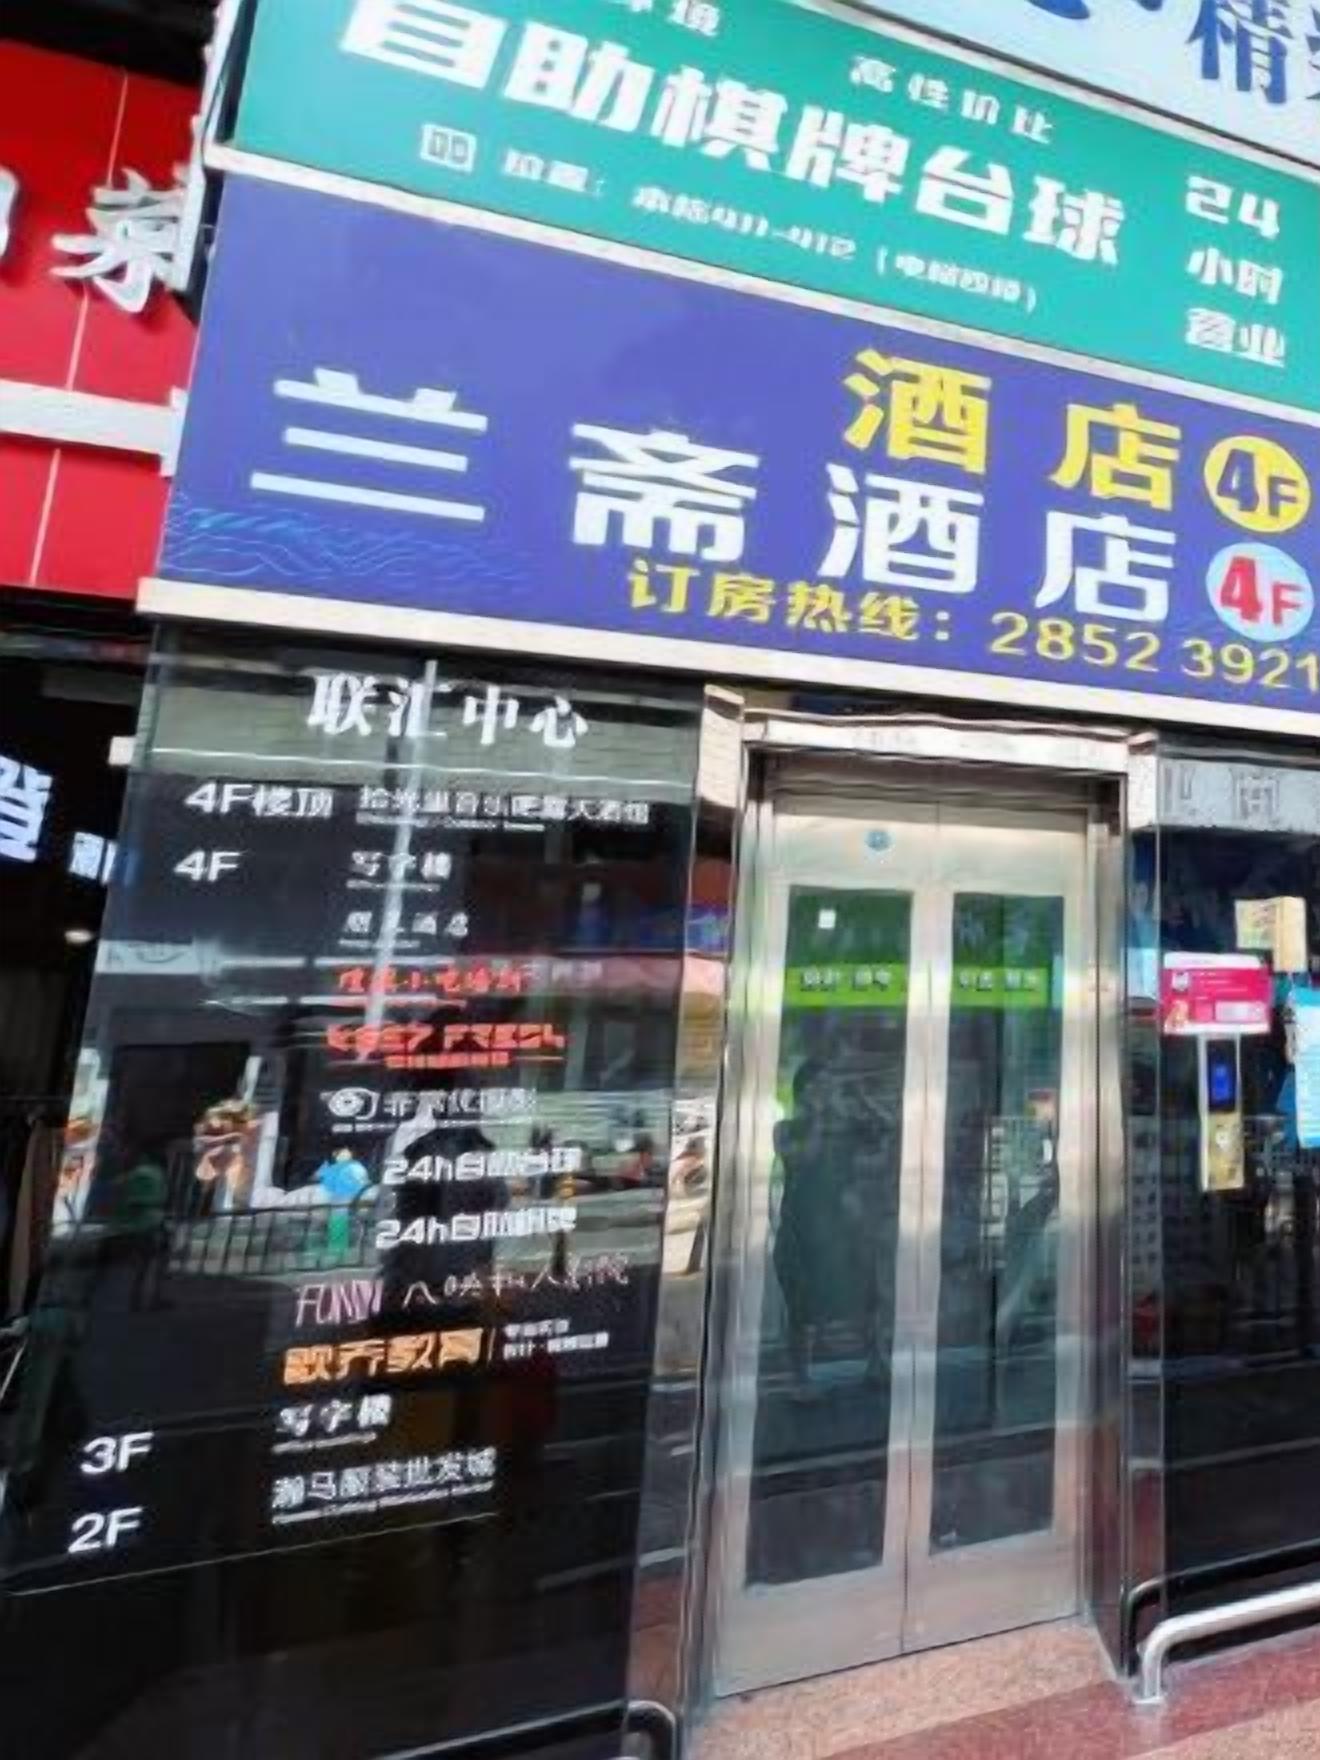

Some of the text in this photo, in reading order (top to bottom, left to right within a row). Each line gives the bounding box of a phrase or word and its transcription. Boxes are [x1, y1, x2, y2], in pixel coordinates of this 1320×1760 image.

[338, 0, 1125, 266] 自助棋牌台球
[1186, 175, 1280, 240] 24
[1186, 248, 1283, 305] 小时
[250, 367, 1306, 628] 兰斋酒店 4F
[1215, 449, 1300, 520] 4F
[988, 611, 1161, 673] 2852
[173, 851, 241, 882] 4F
[80, 1431, 155, 1475] 3F
[66, 1506, 143, 1555] 2F
